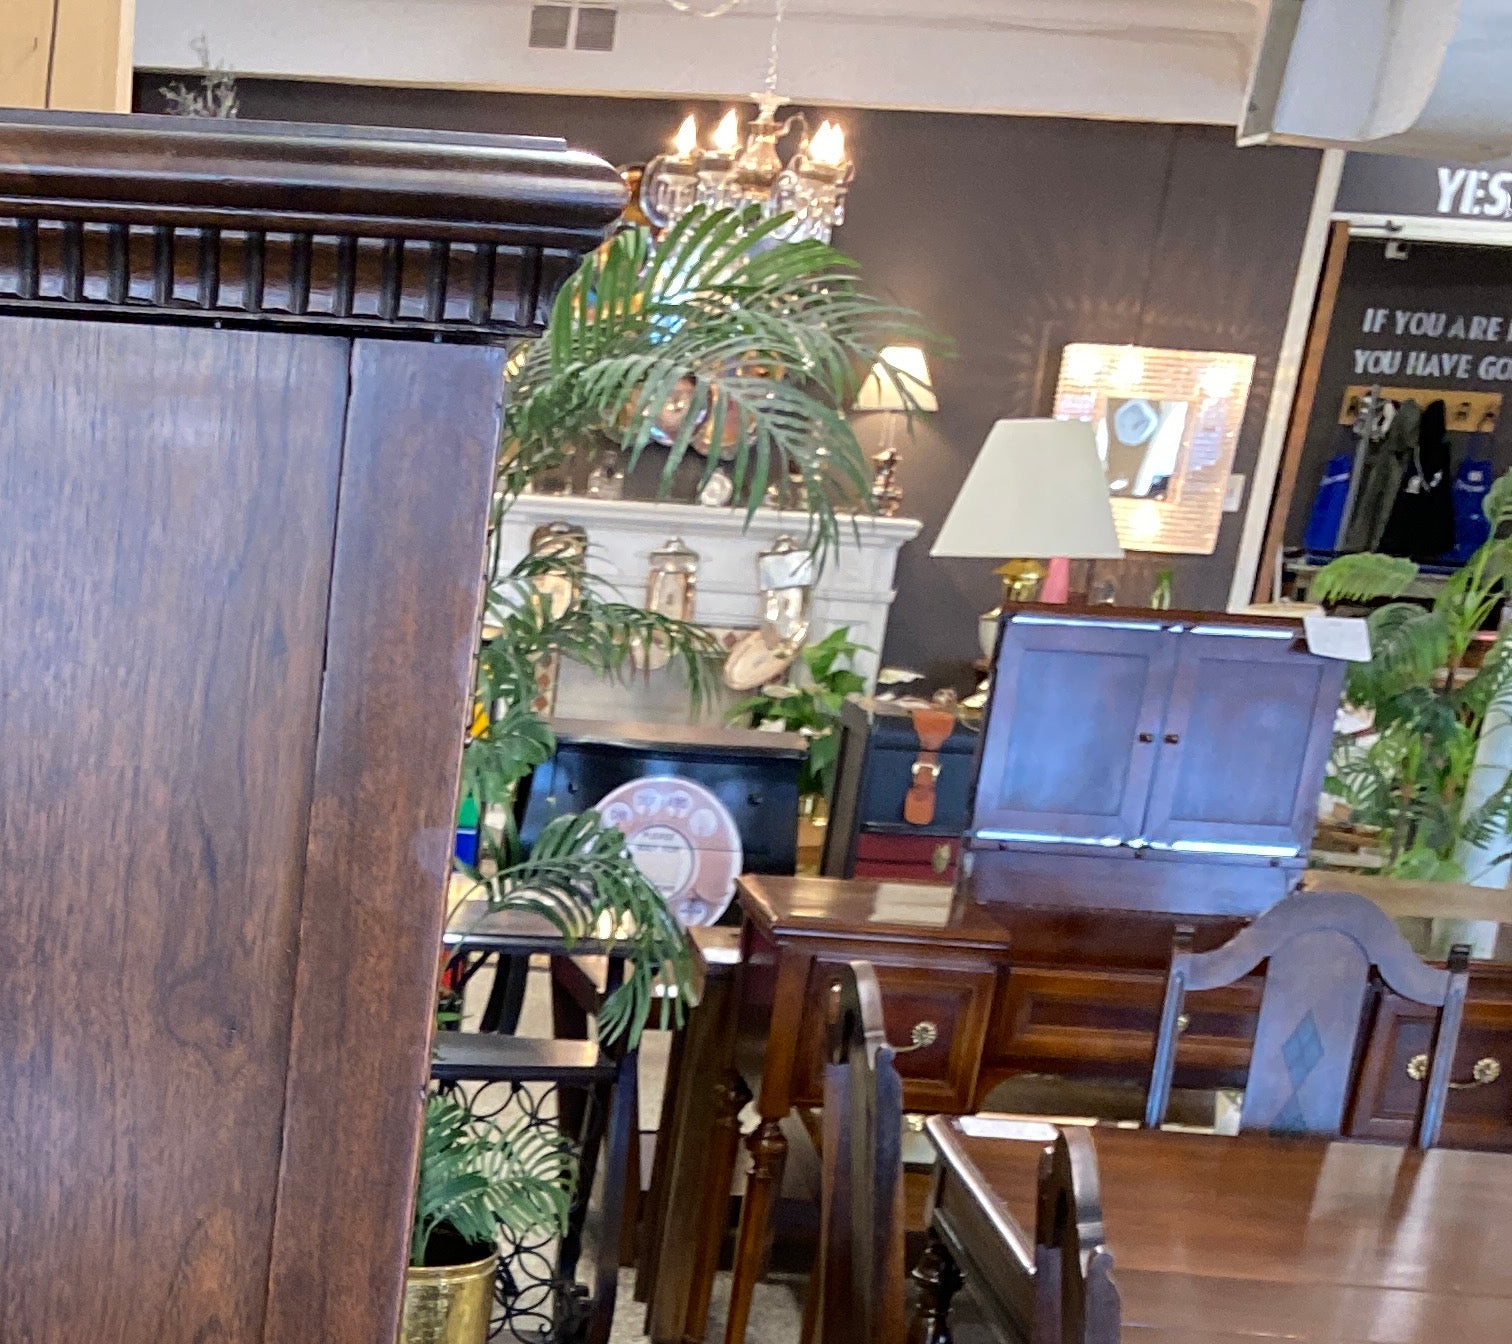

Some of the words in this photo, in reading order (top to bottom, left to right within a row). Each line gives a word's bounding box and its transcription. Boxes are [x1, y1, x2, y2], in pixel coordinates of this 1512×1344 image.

[1362, 308, 1389, 333] IF
[1395, 310, 1447, 337] YOU
[1448, 315, 1504, 341] ARE
[1354, 349, 1403, 375] YOU
[1406, 351, 1474, 379] HAVE
